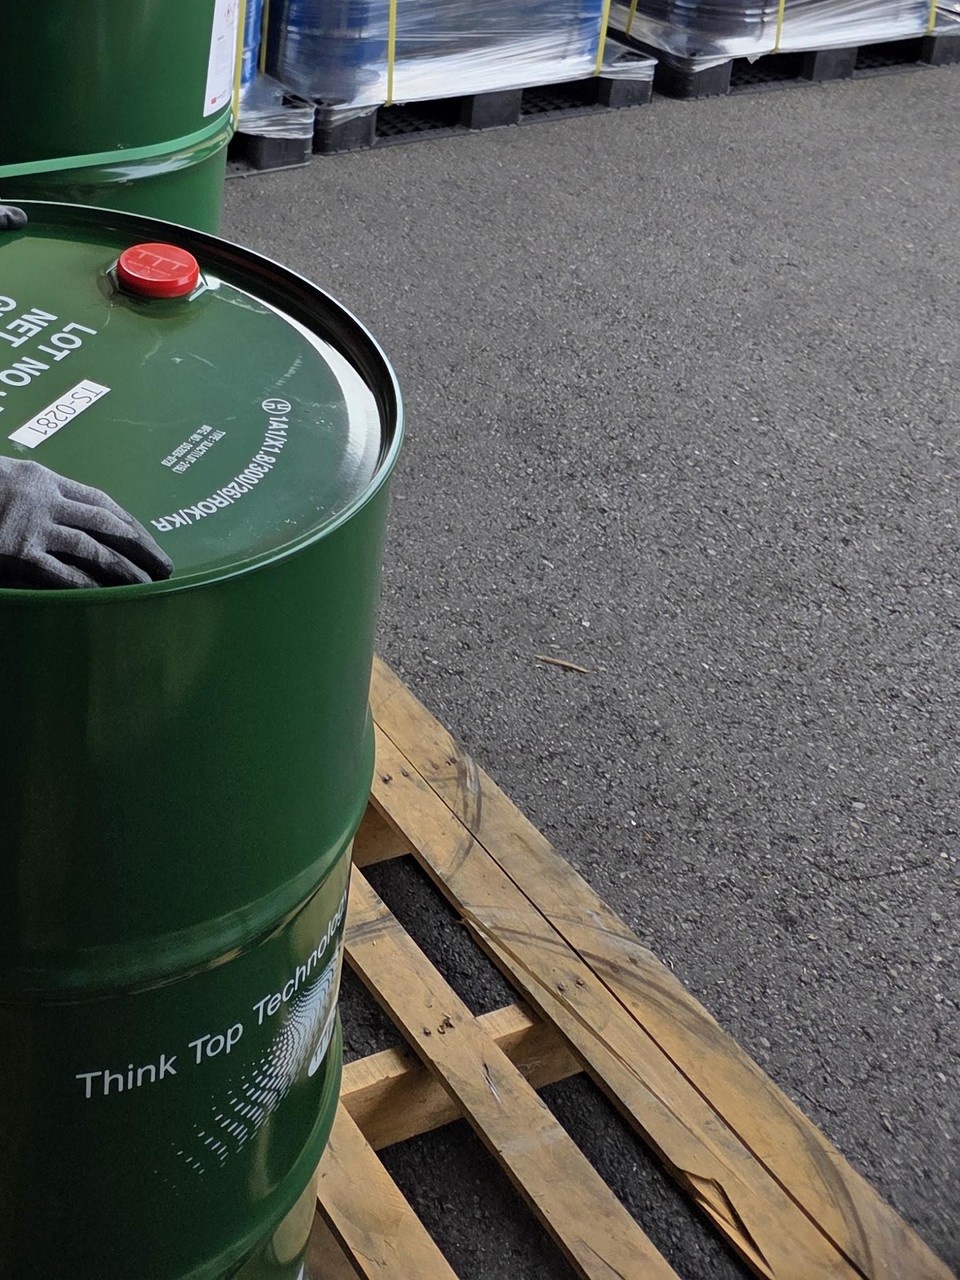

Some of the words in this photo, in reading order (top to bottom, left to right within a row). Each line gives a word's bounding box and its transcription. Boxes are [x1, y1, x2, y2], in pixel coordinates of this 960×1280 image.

[37, 322, 98, 361] LOT
[27, 384, 104, 436] TS-0281
[75, 1053, 177, 1099] Think
[188, 1023, 243, 1064] Top
